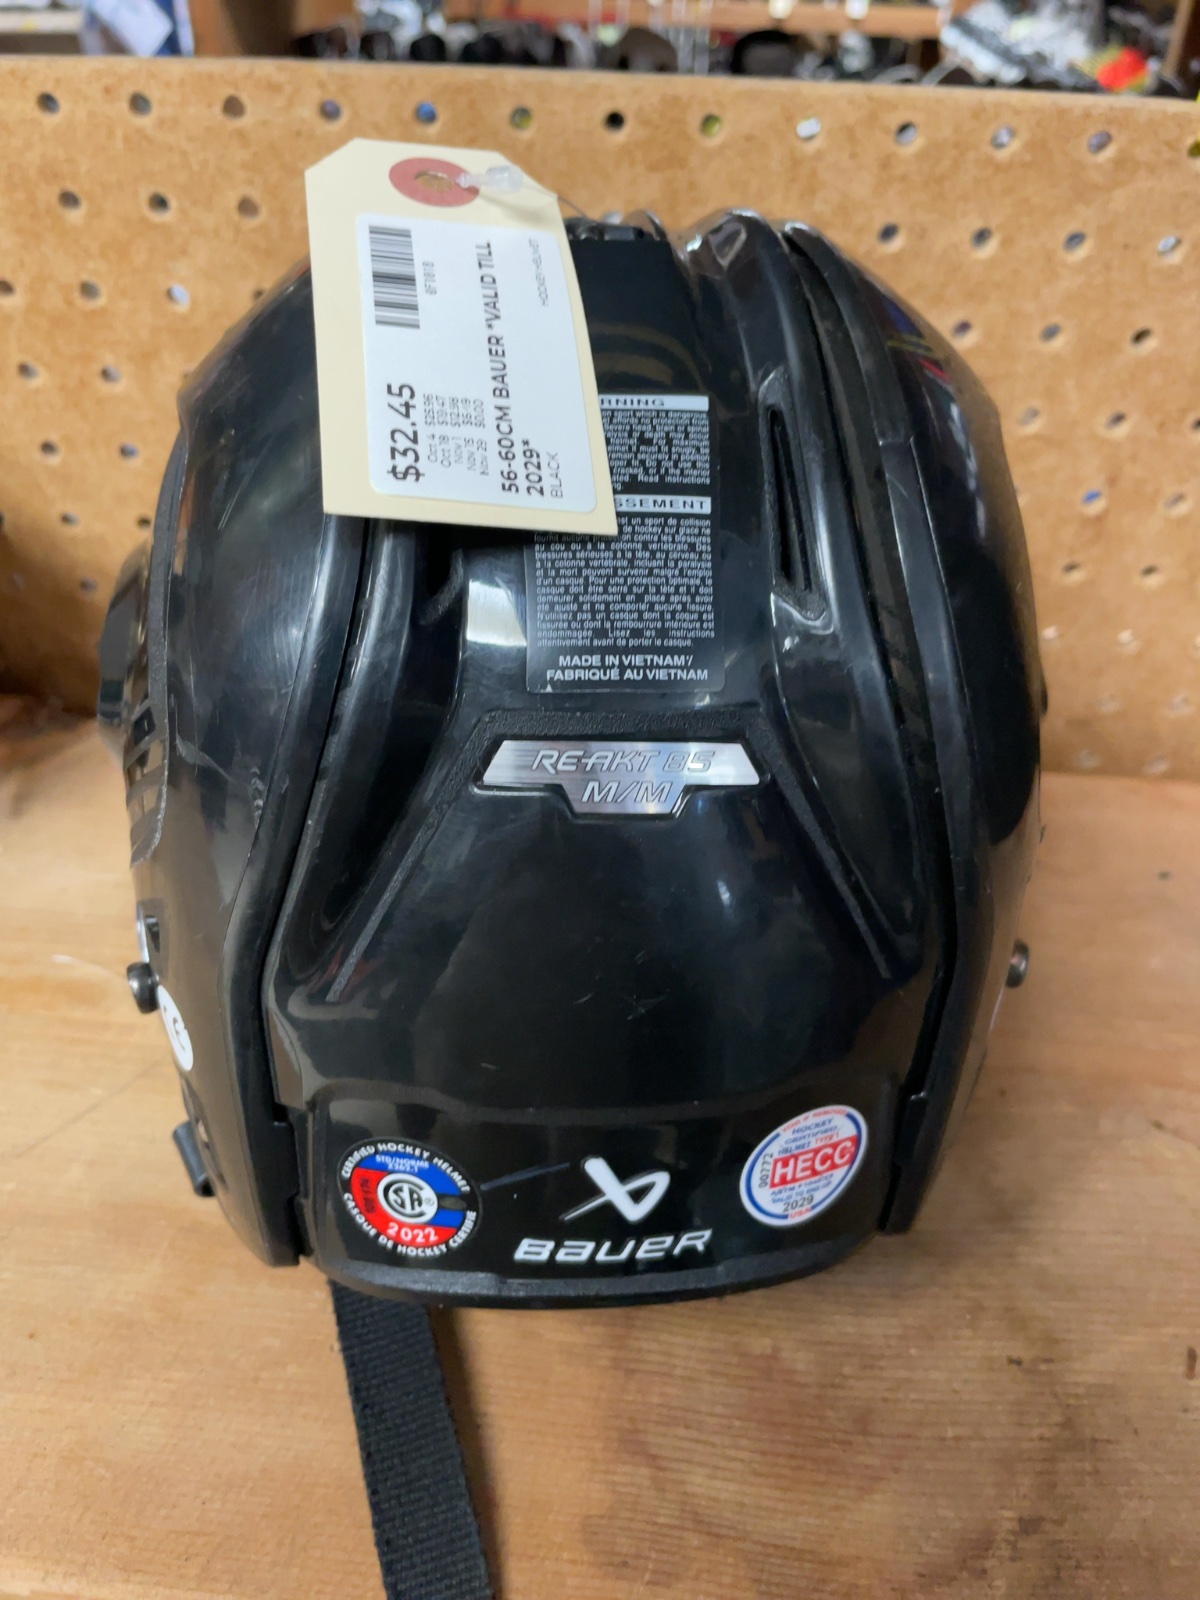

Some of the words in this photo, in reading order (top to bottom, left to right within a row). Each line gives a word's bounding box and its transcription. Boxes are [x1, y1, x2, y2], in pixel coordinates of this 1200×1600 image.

[475, 241, 495, 269] TILL
[487, 334, 511, 399] BAUER
[600, 397, 664, 407] RNING
[386, 383, 425, 483] $32.45
[427, 444, 438, 463] Oct
[439, 449, 451, 468] Oct
[495, 405, 520, 494] 56-60CM
[547, 452, 563, 499] BLACK
[559, 655, 602, 667] MADE
[605, 655, 619, 667] IN
[623, 668, 644, 681] AU
[646, 669, 708, 681] VIETNAM
[531, 750, 660, 775] RE-AKT
[581, 780, 672, 804] M/M
[791, 1117, 834, 1135] HOCKEY
[377, 1142, 431, 1159] HOCKEY
[432, 1156, 471, 1194] HELMET
[773, 1140, 852, 1185] HECC
[783, 1195, 814, 1213] 2029
[343, 1192, 378, 1237] CASQUE
[377, 1235, 394, 1249] DE
[397, 1242, 447, 1257] HOCKEY
[387, 1221, 439, 1243] 2022
